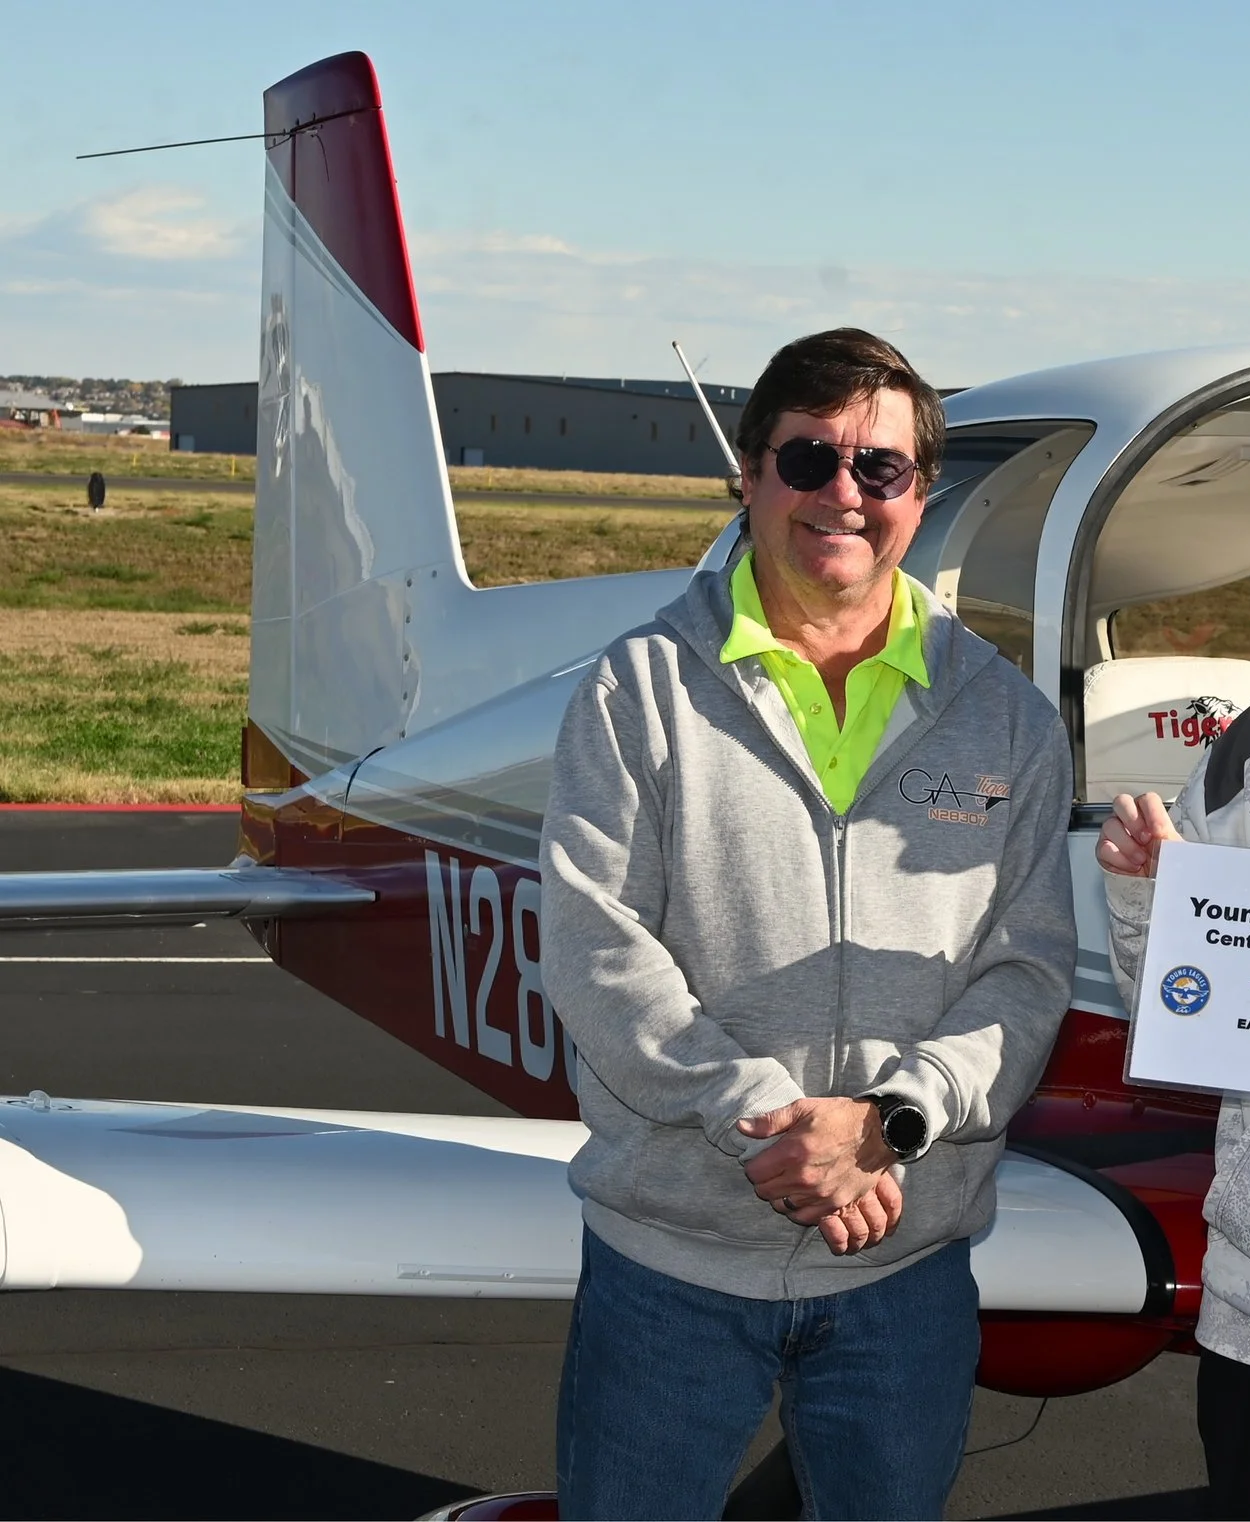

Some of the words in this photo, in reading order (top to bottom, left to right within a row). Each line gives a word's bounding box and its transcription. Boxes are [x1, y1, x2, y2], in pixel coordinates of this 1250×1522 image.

[1147, 709, 1233, 747] Tiger
[927, 807, 988, 827] N28307
[424, 848, 579, 1097] N28
[1166, 968, 1187, 983] YOUNG
[1188, 969, 1207, 988] EAGLES
